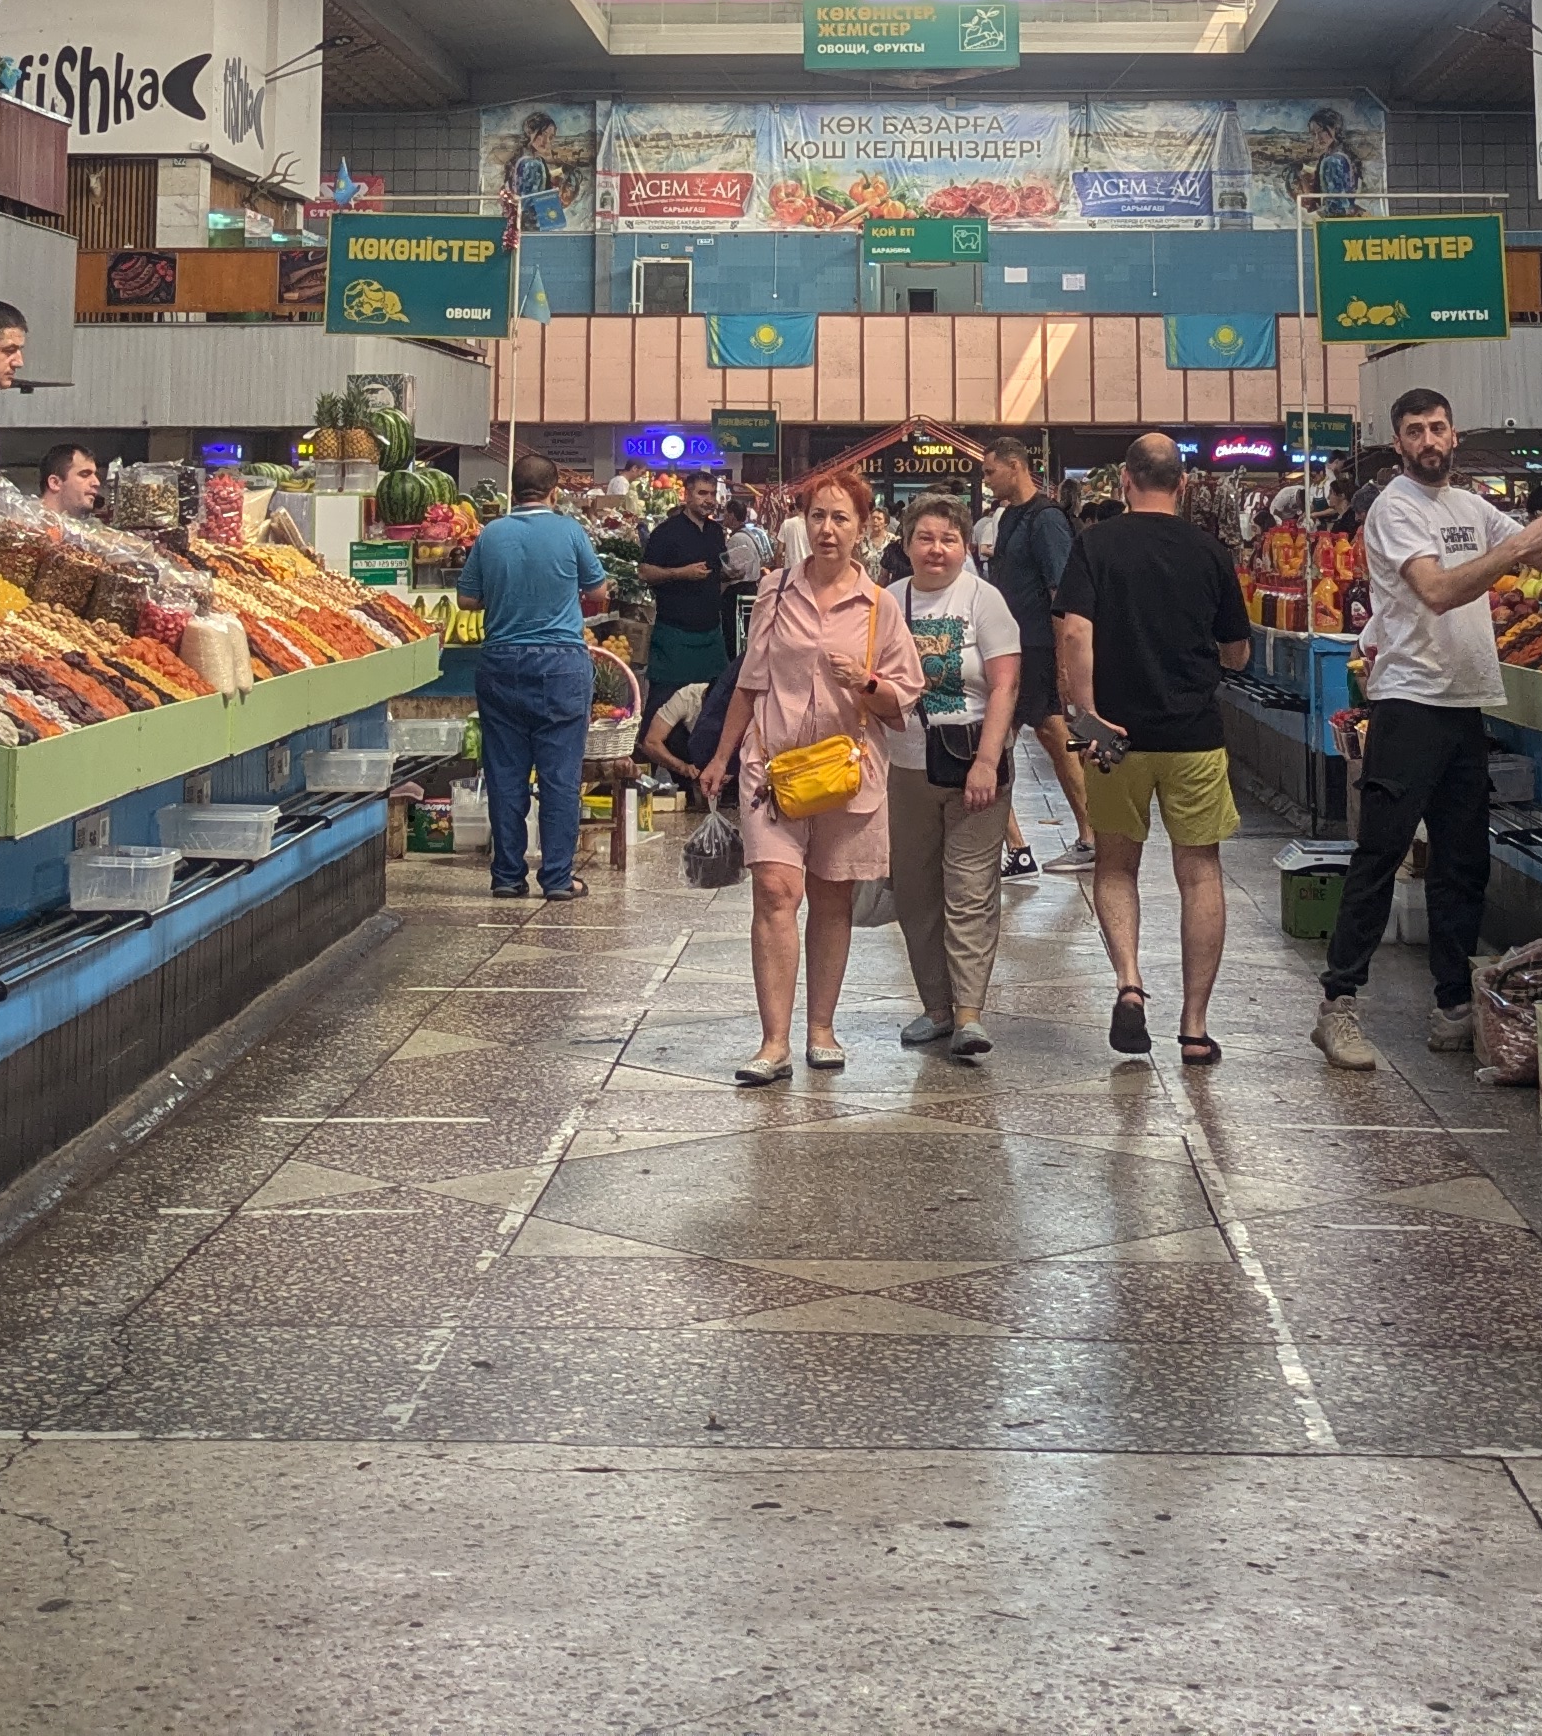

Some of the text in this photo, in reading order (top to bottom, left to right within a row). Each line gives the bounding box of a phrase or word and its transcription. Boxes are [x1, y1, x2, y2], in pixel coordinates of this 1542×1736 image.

[818, 22, 911, 38] ЖЕМІСТЕР
[817, 43, 925, 55] ОВОЩИ, ФРУКТЫ
[820, 116, 1004, 135] КӨК БАЗАРҒА
[784, 140, 1042, 162] ҚОШ КЕЛДІҢІЗДЕР!
[629, 178, 741, 201] АСЕМ АЙ
[1086, 178, 1148, 201] АСЕМ
[1171, 177, 1201, 200] АЙ
[1343, 235, 1473, 262] ЖЕМІСТЕР
[445, 307, 491, 321] ОВОЩИ
[1430, 309, 1489, 322] ФРУКТЫ
[894, 459, 972, 473] ЗОЛОТО
